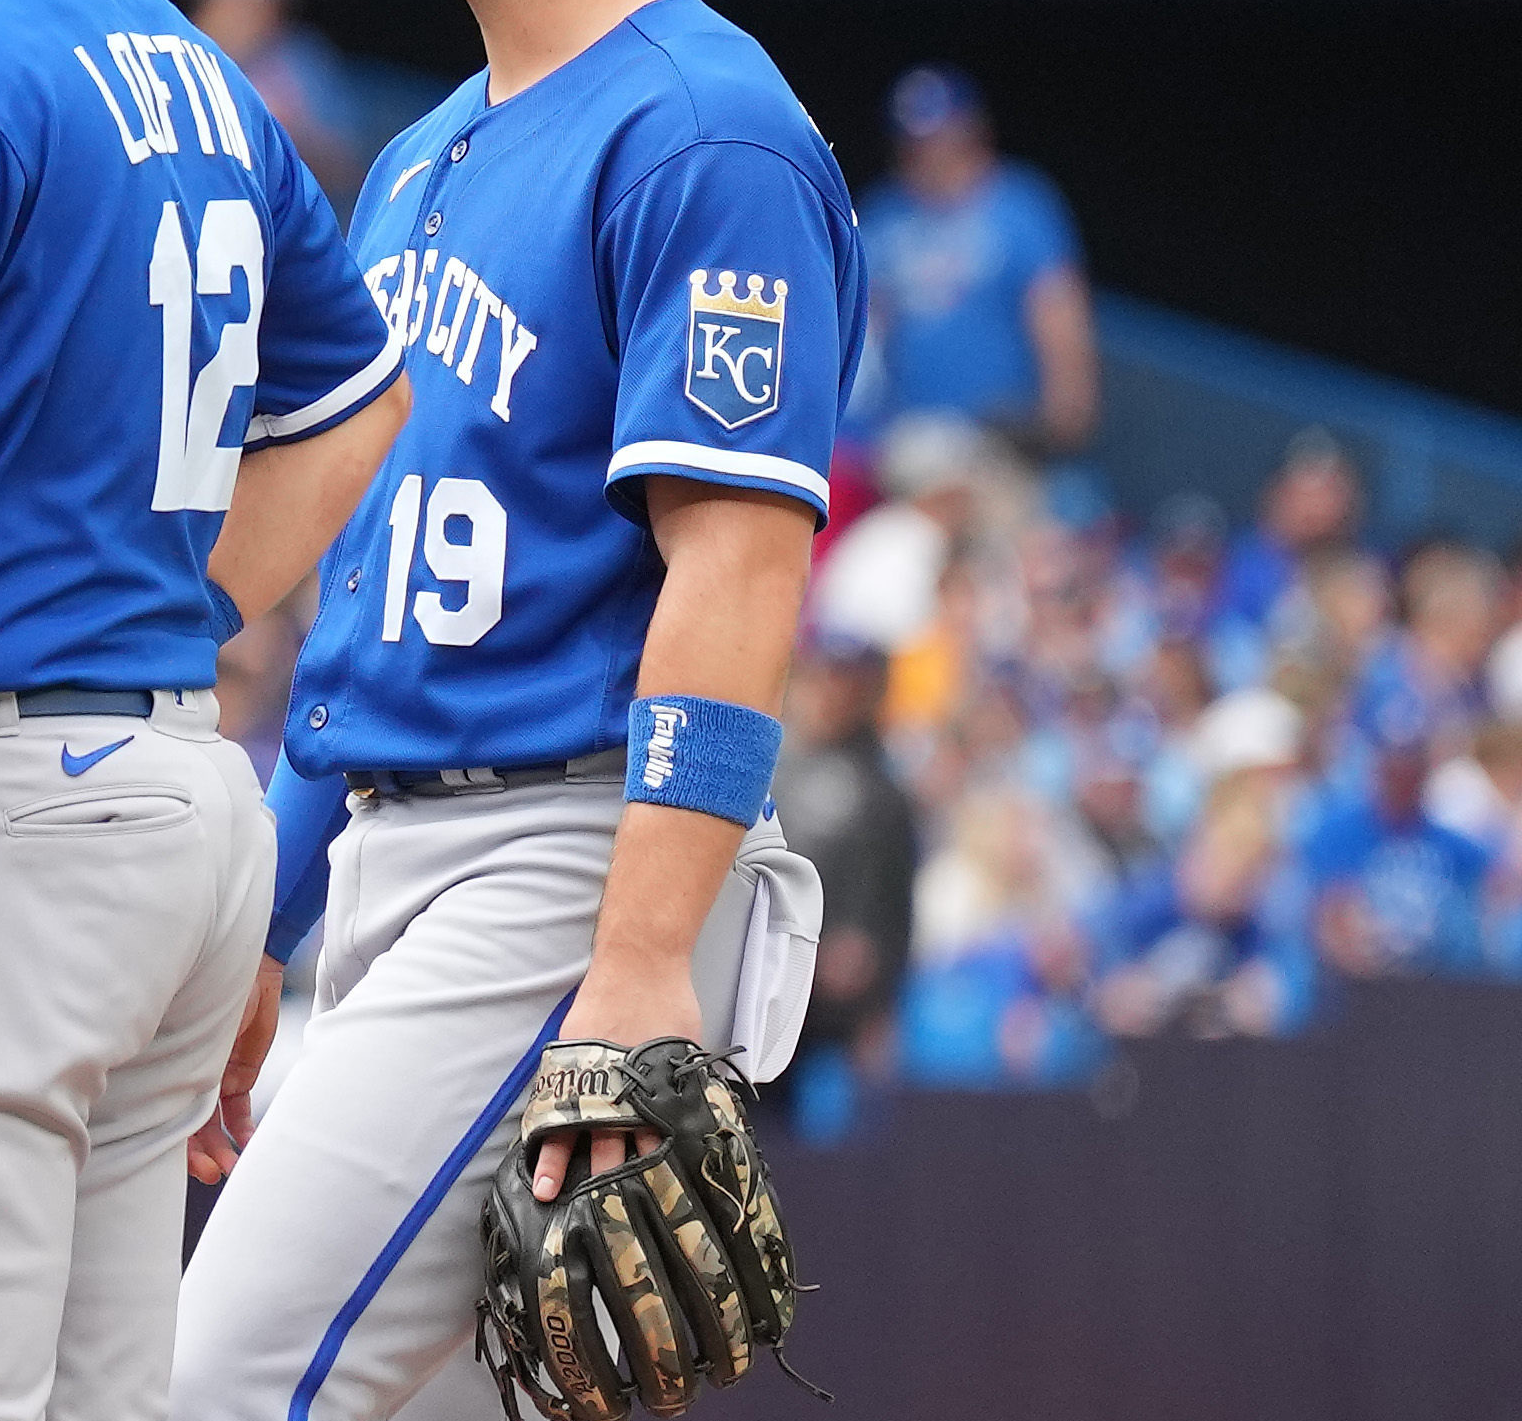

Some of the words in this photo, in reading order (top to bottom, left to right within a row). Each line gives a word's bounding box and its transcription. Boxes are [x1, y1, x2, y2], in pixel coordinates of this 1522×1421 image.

[73, 32, 252, 172] LOFTIN
[148, 198, 266, 513] 12
[426, 256, 538, 423] CITY
[696, 323, 772, 404] KC
[381, 473, 508, 647] 19
[643, 704, 688, 788] Franklin
[534, 1066, 612, 1102] Wilso
[546, 1315, 594, 1395] A2000
